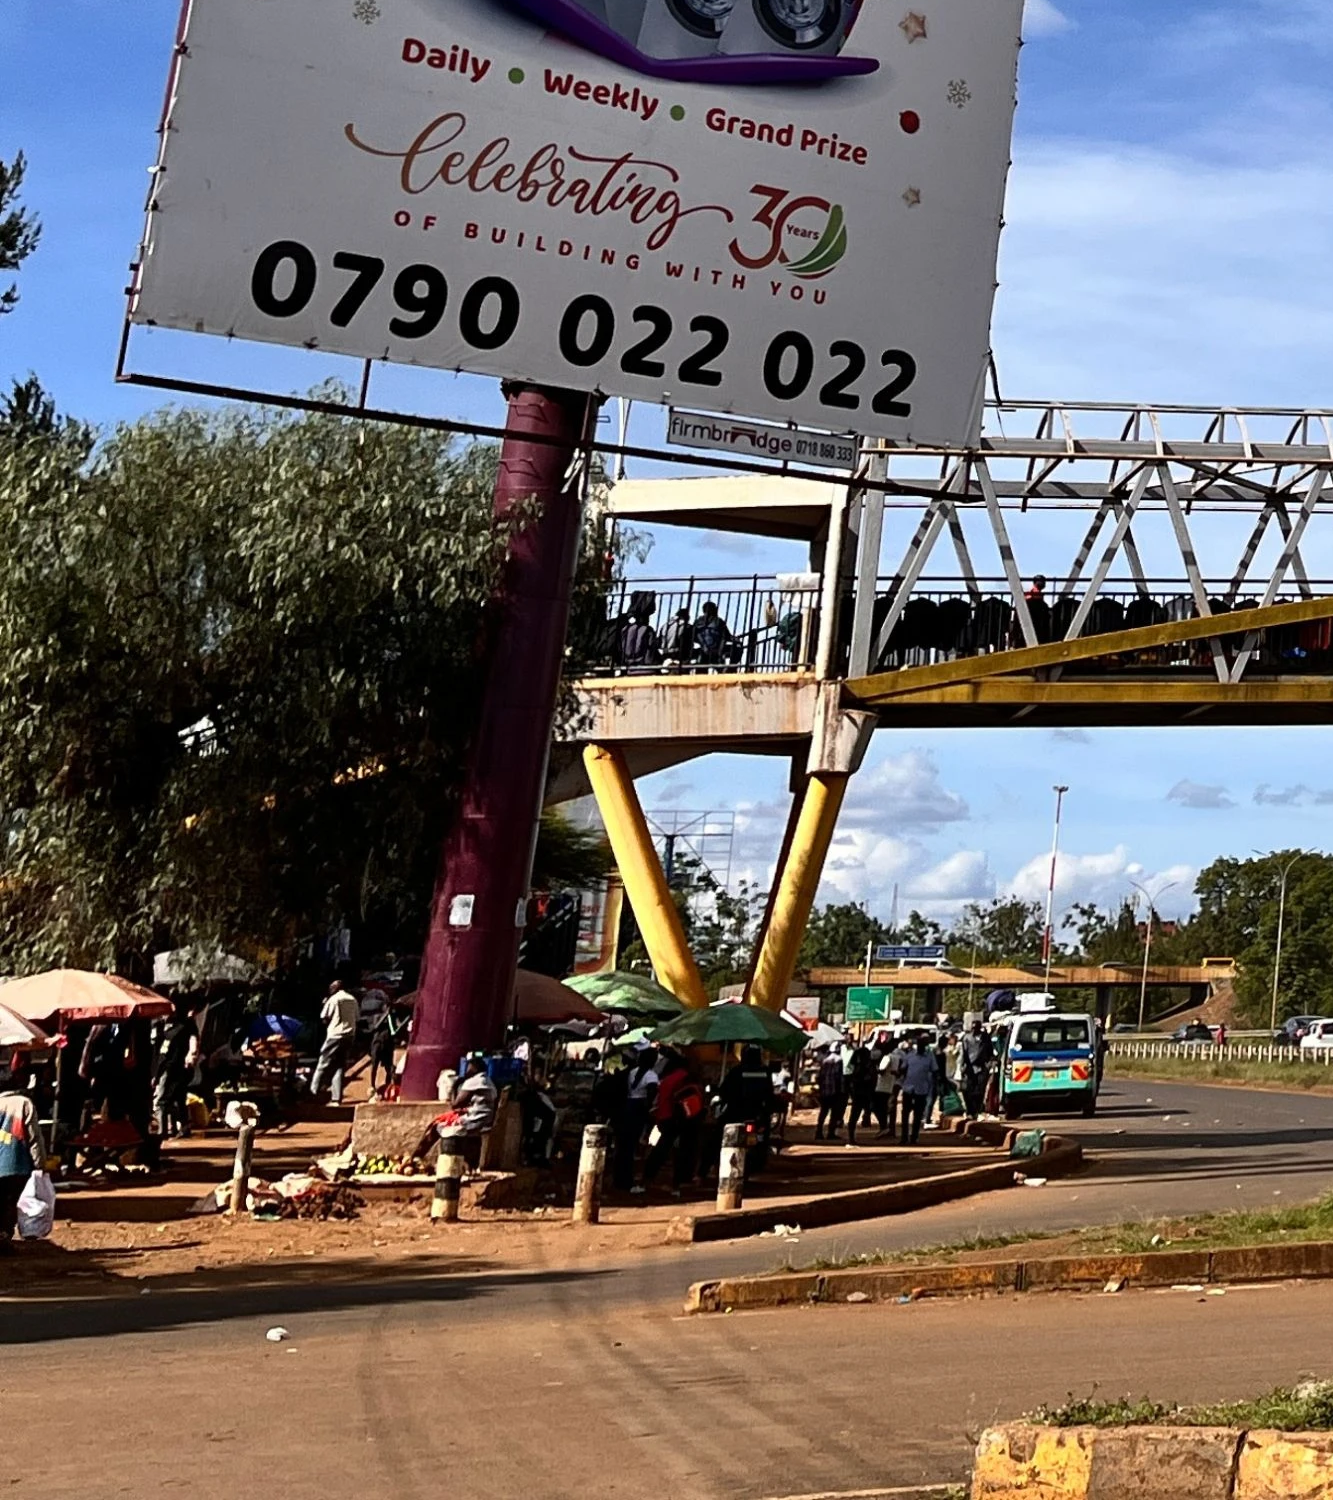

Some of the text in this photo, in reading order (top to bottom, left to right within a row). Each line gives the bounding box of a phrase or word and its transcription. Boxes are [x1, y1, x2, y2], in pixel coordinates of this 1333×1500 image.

[401, 37, 869, 165] Daily Weekly Grand Prize
[344, 111, 848, 280] Celebrating 30
[786, 223, 820, 241] Years
[394, 210, 827, 305] OF BUILDING WITH YOU
[249, 238, 919, 419] 0790 022 022
[796, 438, 818, 456] 0718
[820, 442, 834, 460] 860
[835, 445, 853, 462] 333
